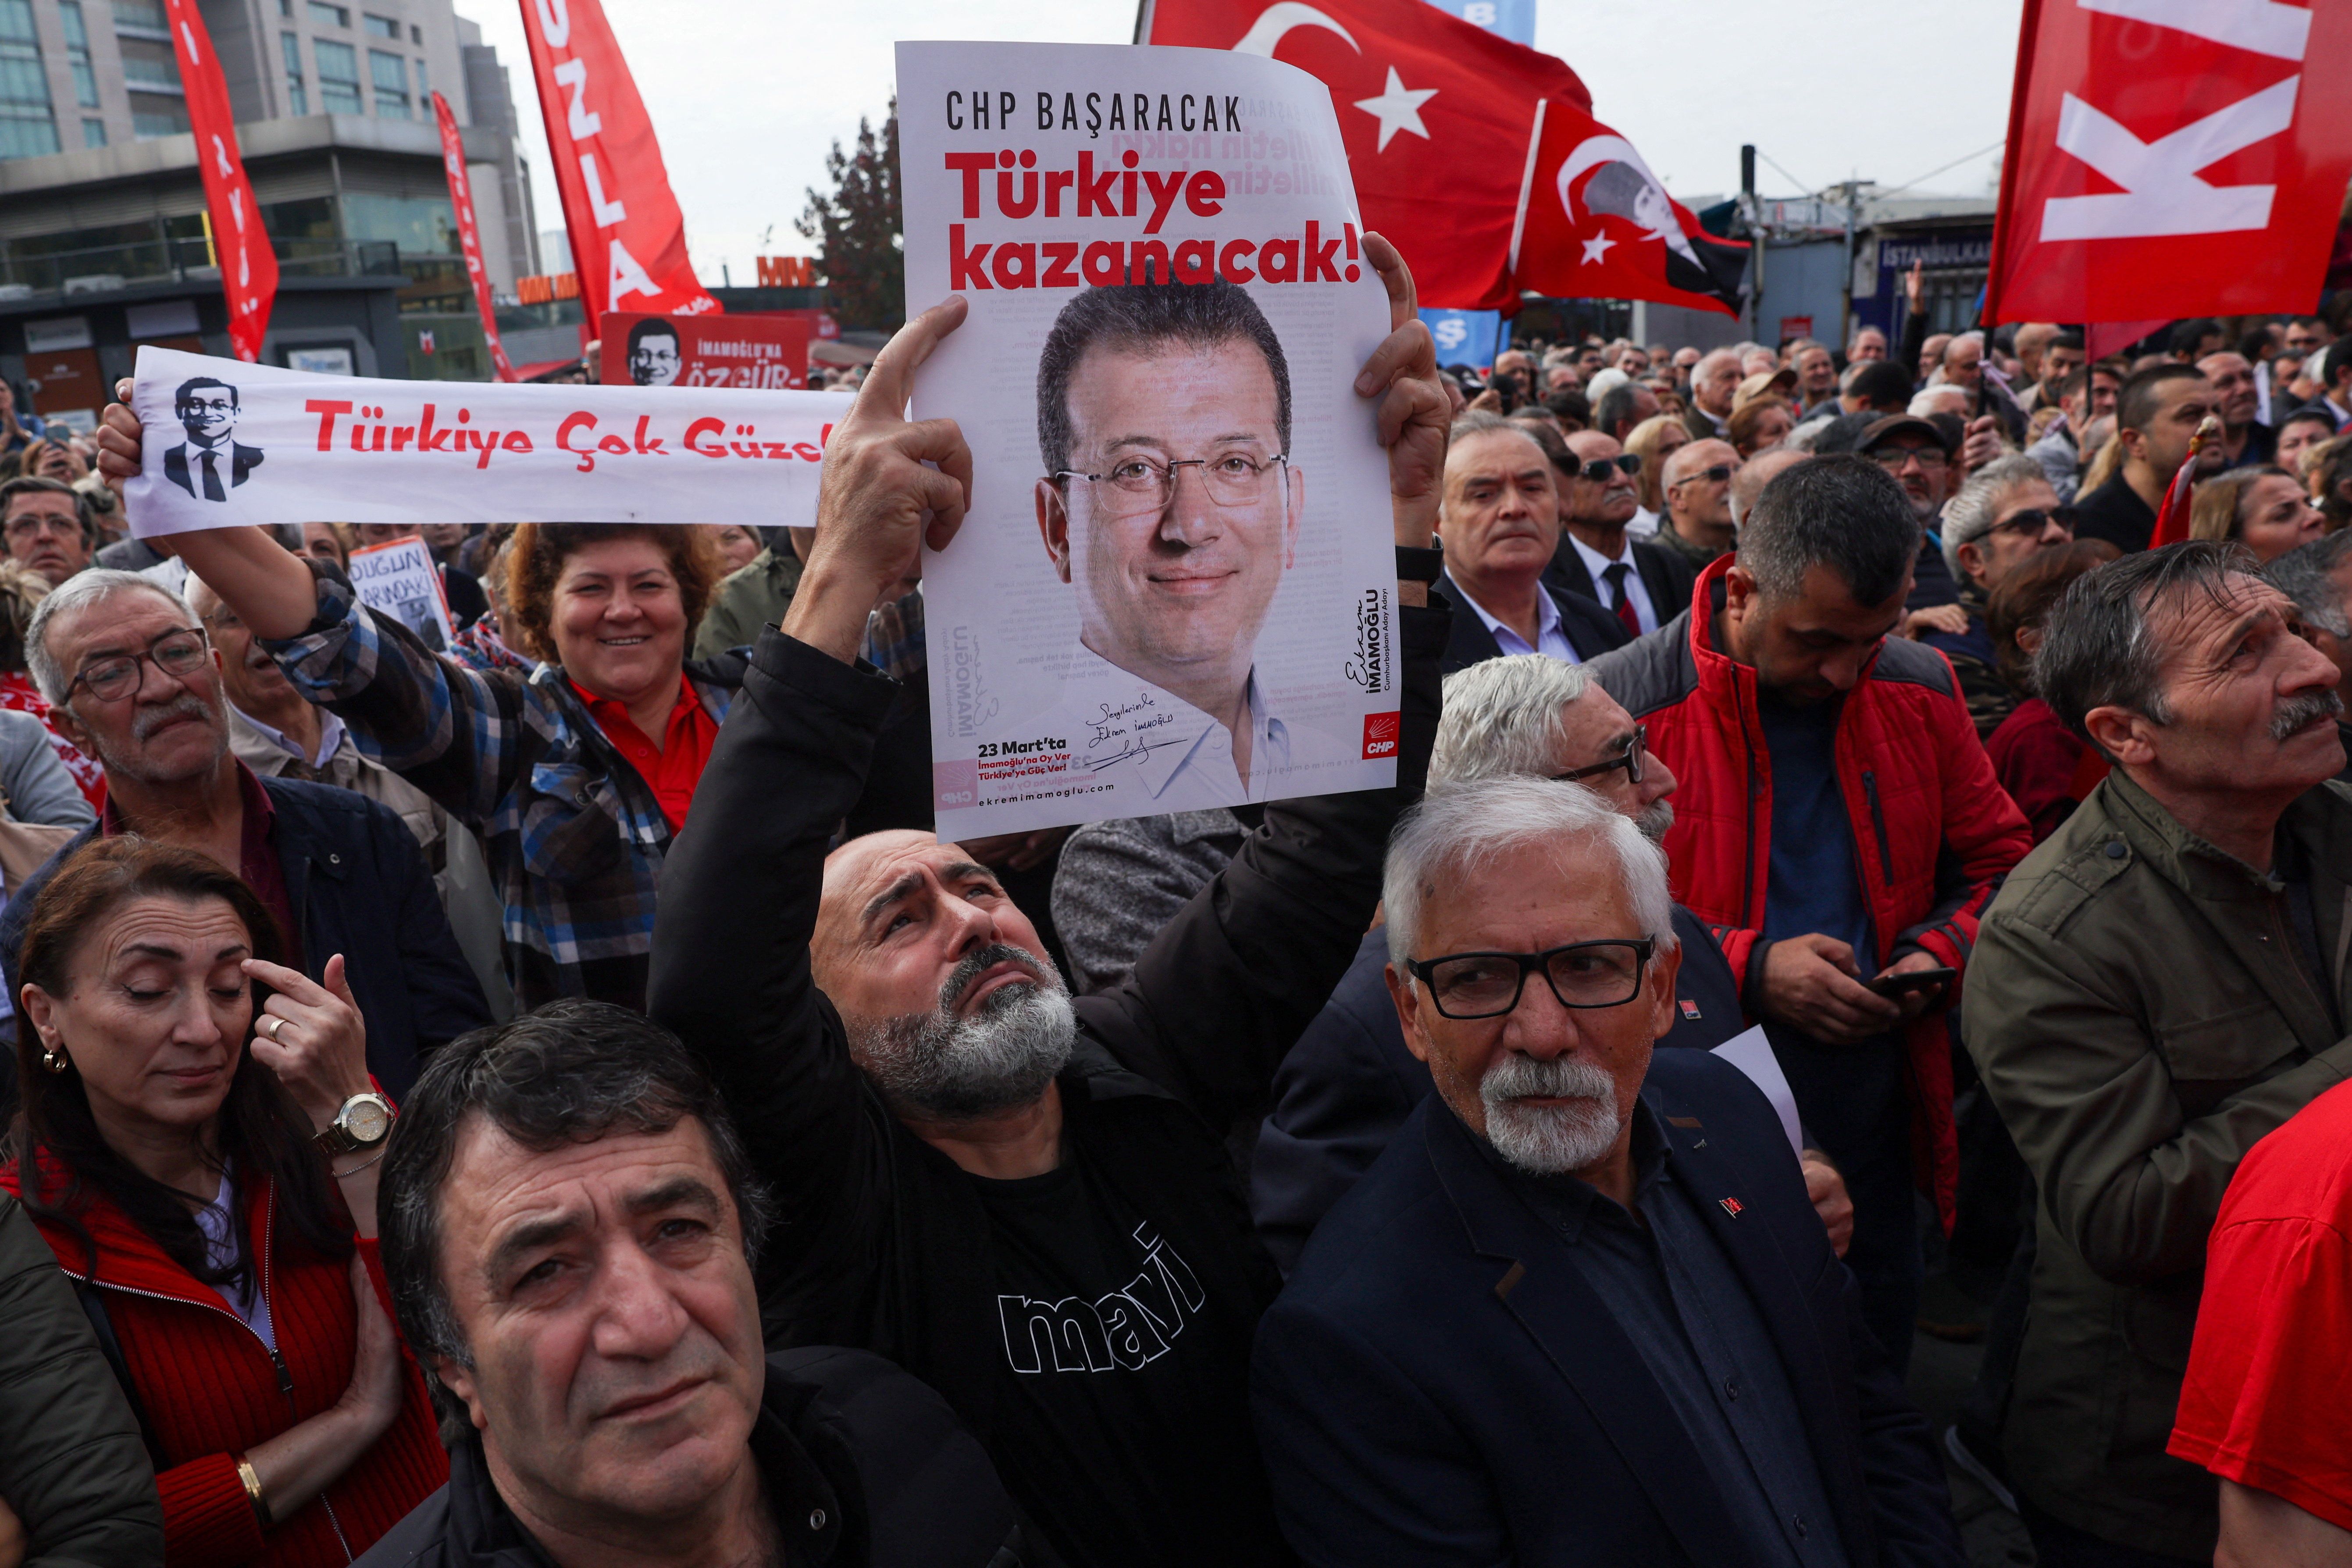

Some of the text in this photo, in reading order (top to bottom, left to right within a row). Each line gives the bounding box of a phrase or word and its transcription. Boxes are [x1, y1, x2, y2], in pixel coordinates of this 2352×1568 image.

[947, 91, 1240, 138] CHP BAŞARACAK
[945, 149, 1226, 234] Türkiye
[950, 220, 1360, 290] kazanacak!
[306, 400, 533, 468] Türkiye
[556, 411, 670, 472] Çok
[1365, 589, 1381, 694] İMAMOĞLU
[978, 743, 998, 758] 23
[1002, 737, 1066, 755] Mart'ta
[978, 756, 1037, 770] İmamoğlu'na
[1040, 754, 1053, 764] Oy
[1055, 752, 1071, 761] Ver
[1367, 740, 1395, 755] CHP
[978, 768, 1026, 780] Türkiye'ye
[1028, 766, 1046, 775] Güç
[1048, 763, 1067, 772] Ver!
[979, 784, 1114, 806] ekremimamoglu.com
[998, 1220, 1205, 1373] mavi
